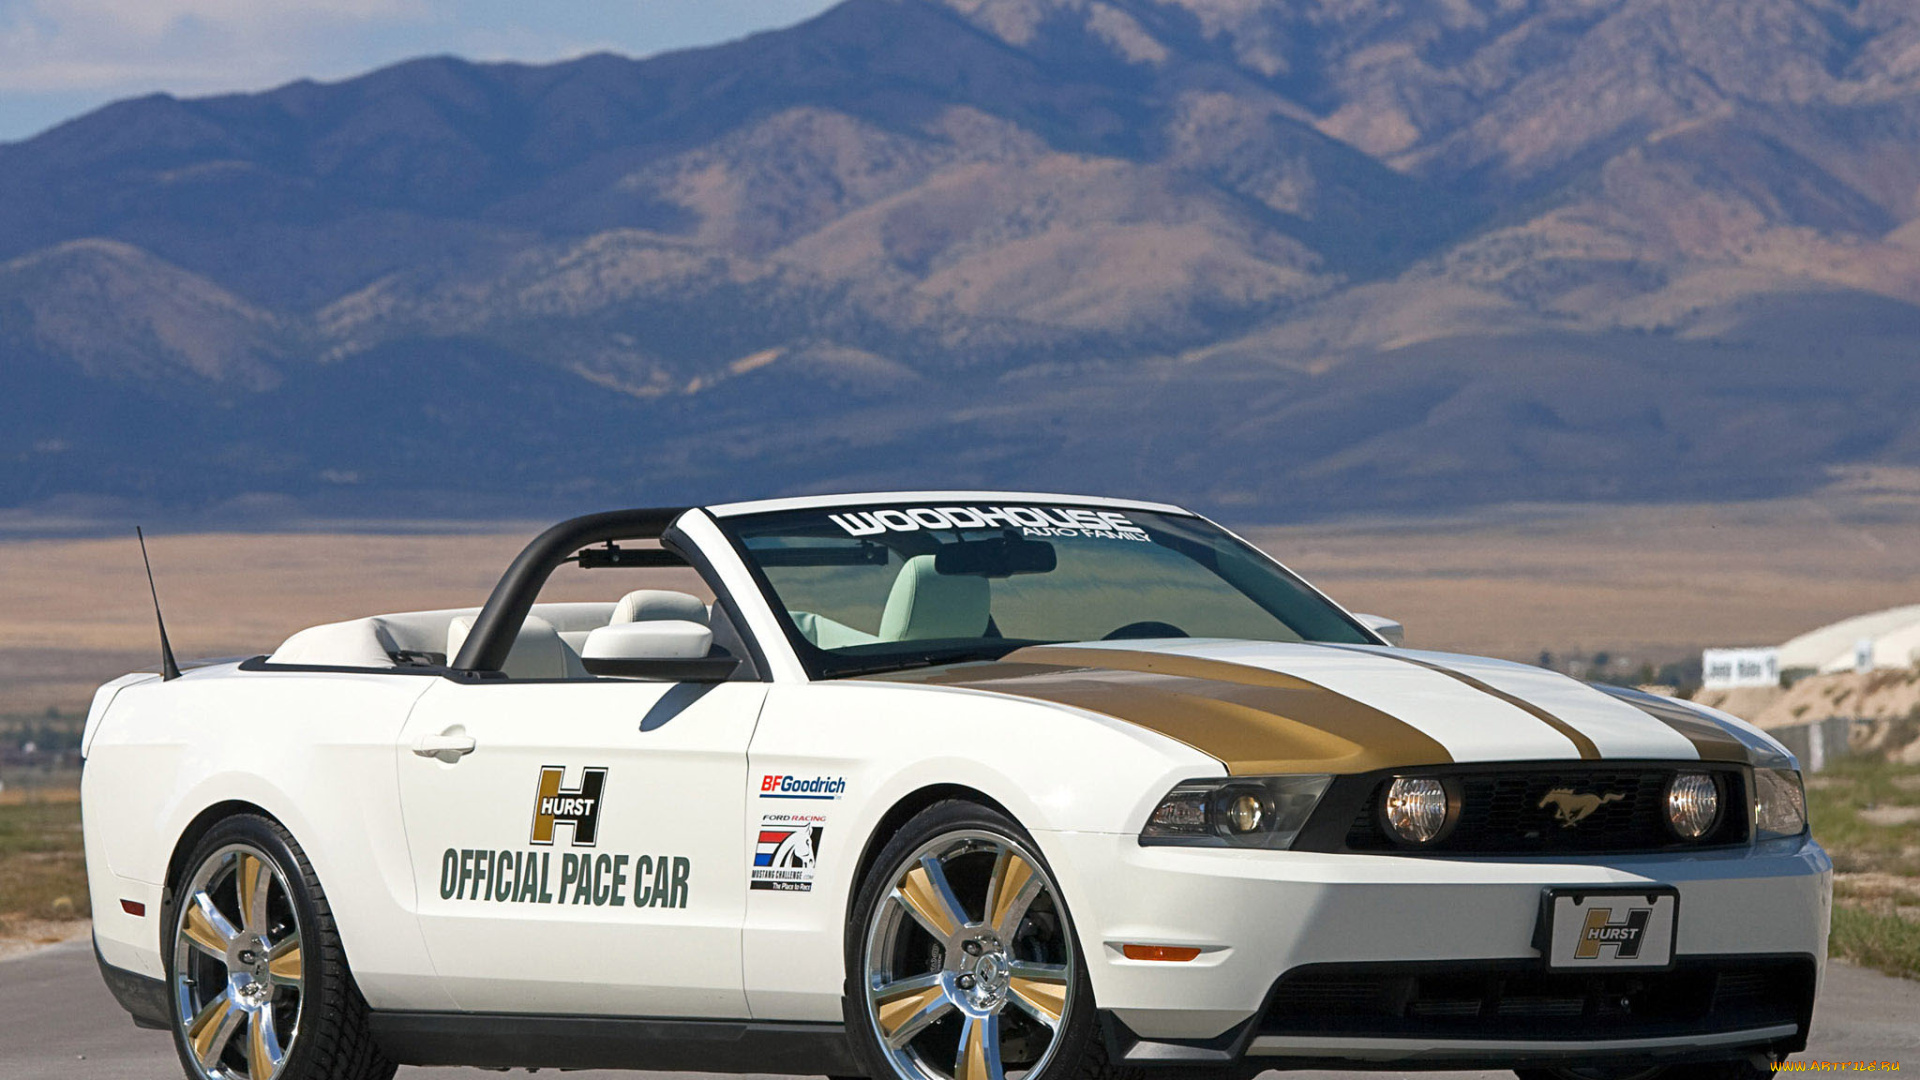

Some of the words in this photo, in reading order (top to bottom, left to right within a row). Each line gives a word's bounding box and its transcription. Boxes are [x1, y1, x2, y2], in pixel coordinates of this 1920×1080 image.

[828, 507, 1144, 536] WOODHOUSE
[1022, 526, 1079, 538] AUTO
[1081, 528, 1153, 543] FAMILY
[761, 774, 846, 794] BFGoodrich
[540, 797, 595, 817] HURST
[440, 848, 553, 904] OFFICIAL
[558, 853, 629, 907] PACE
[633, 855, 691, 909] CAR
[751, 870, 775, 879] MUSTANG
[775, 870, 803, 880] CHALLENGE
[1587, 928, 1638, 940] HURST
